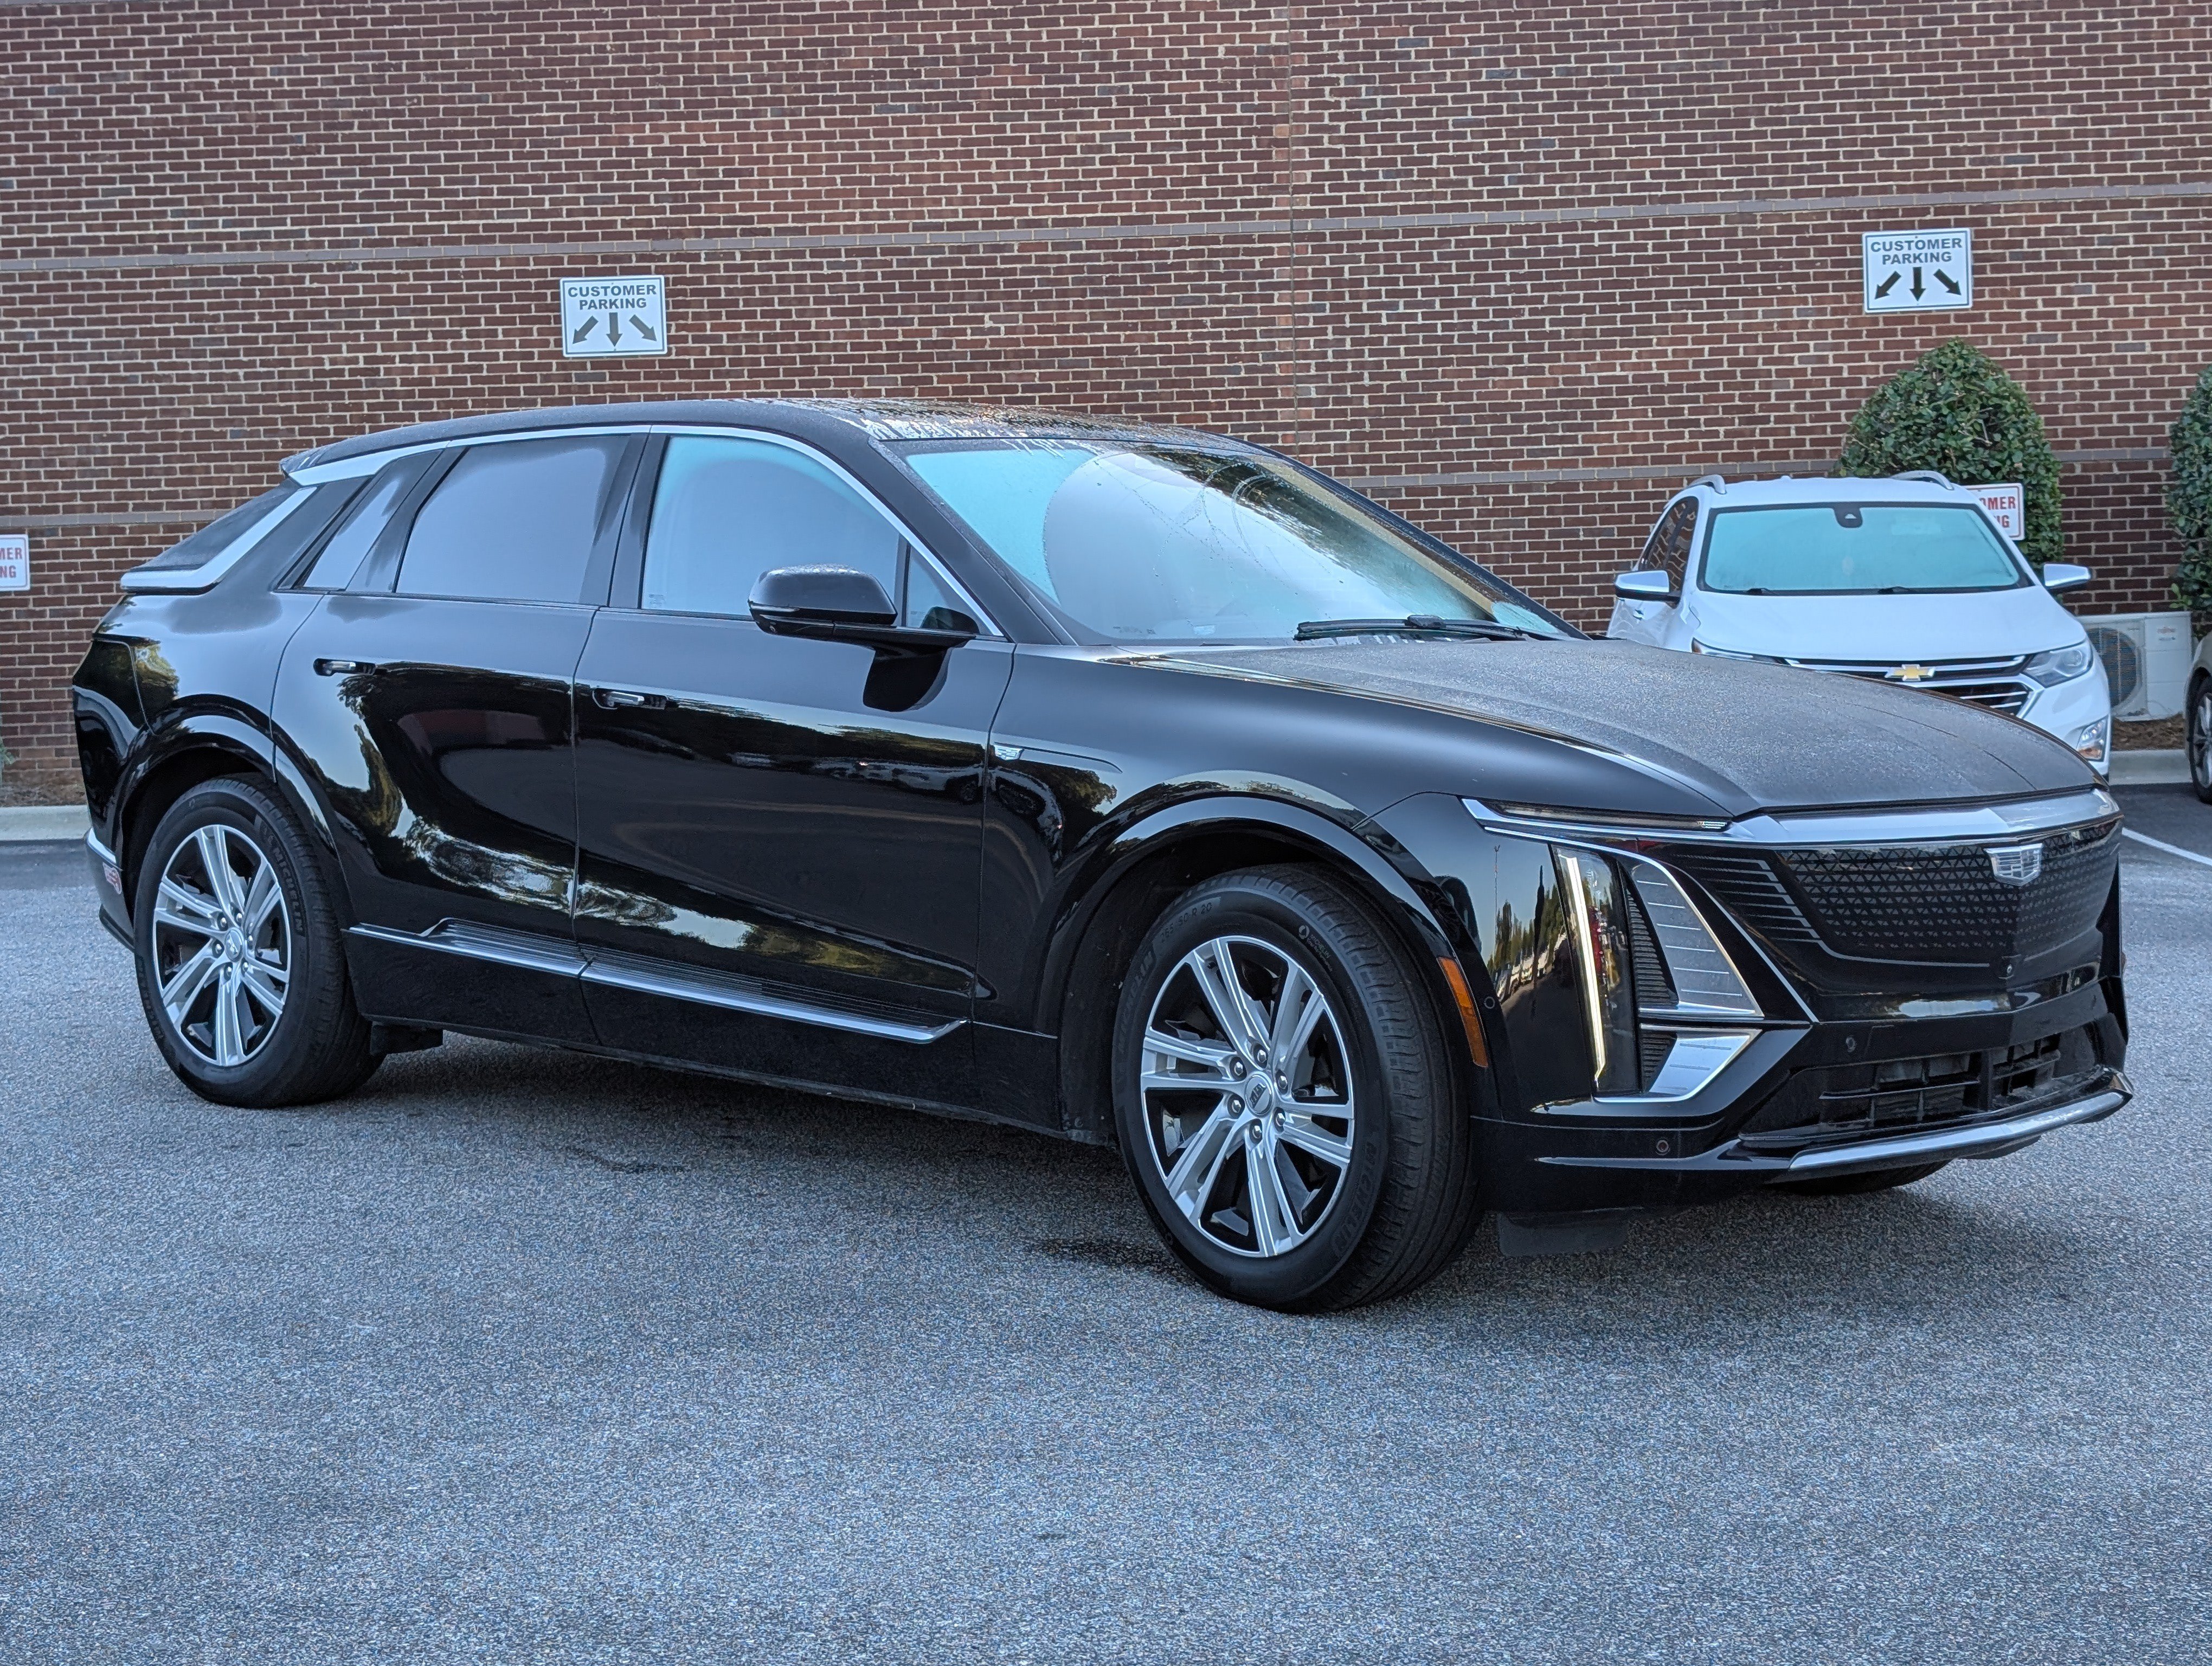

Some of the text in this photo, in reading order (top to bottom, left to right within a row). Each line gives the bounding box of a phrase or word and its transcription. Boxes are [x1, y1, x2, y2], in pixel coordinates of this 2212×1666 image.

[1871, 238, 1962, 252] CUSTOMER
[1882, 252, 1952, 265] PARKING
[568, 285, 657, 297] CUSTOMER
[580, 298, 647, 310] PARKING
